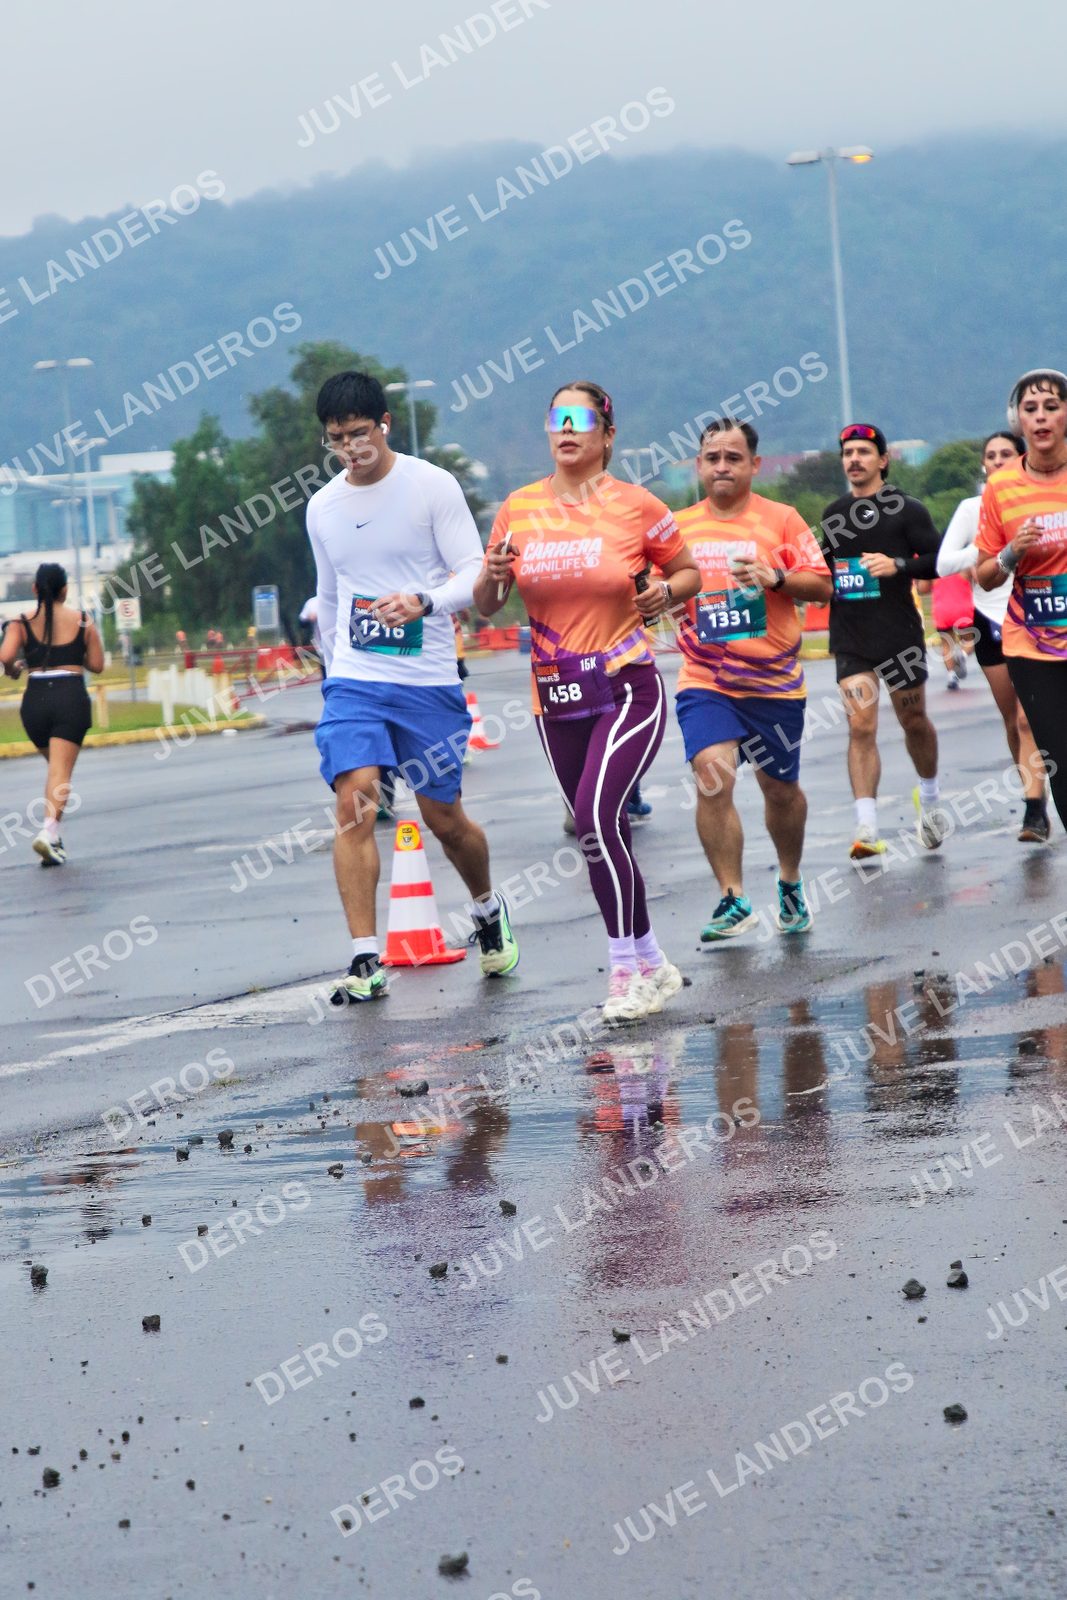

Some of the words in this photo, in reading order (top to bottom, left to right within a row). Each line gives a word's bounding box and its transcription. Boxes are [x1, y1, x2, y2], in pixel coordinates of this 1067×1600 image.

[523, 537, 603, 561] CARRERA
[692, 540, 757, 559] CARRRA
[520, 557, 581, 576] OMNILIFE
[839, 575, 864, 588] 1570
[1034, 596, 1067, 612] 115
[708, 609, 750, 628] 1331
[360, 619, 405, 640] 1216
[549, 683, 582, 703] 458
